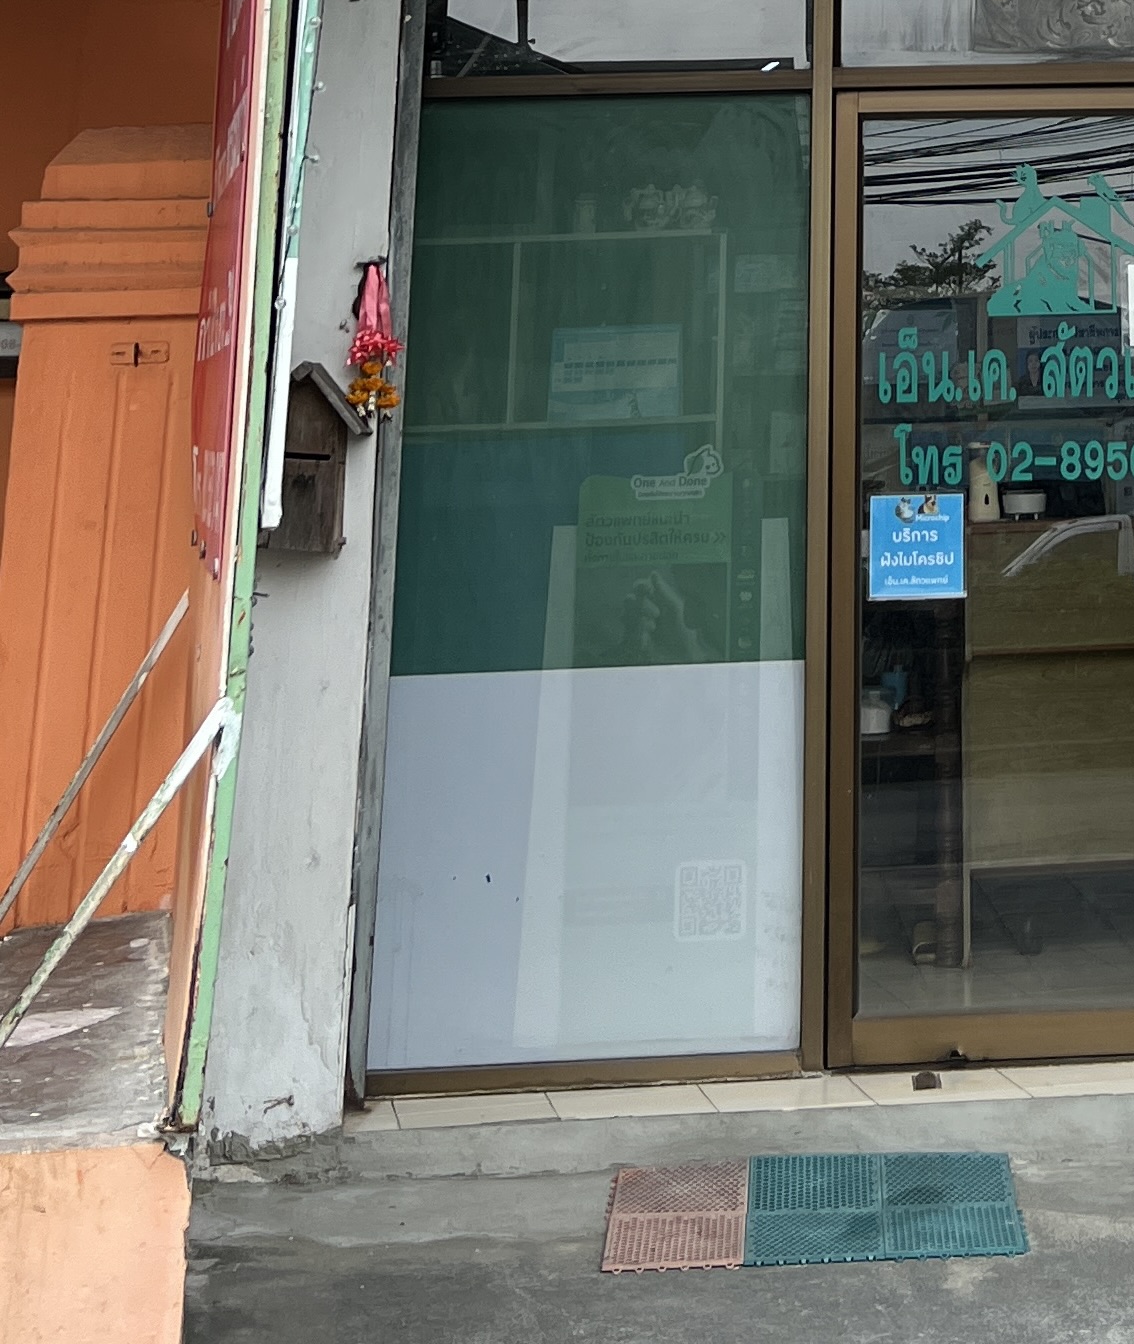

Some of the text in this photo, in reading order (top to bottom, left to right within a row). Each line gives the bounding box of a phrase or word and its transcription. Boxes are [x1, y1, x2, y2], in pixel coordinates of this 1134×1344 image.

[878, 326, 1018, 404] เอ็น.เค.
[894, 424, 963, 486] โทร
[892, 528, 938, 543] บริการ
[881, 551, 954, 567] ฝังไมโครชิป
